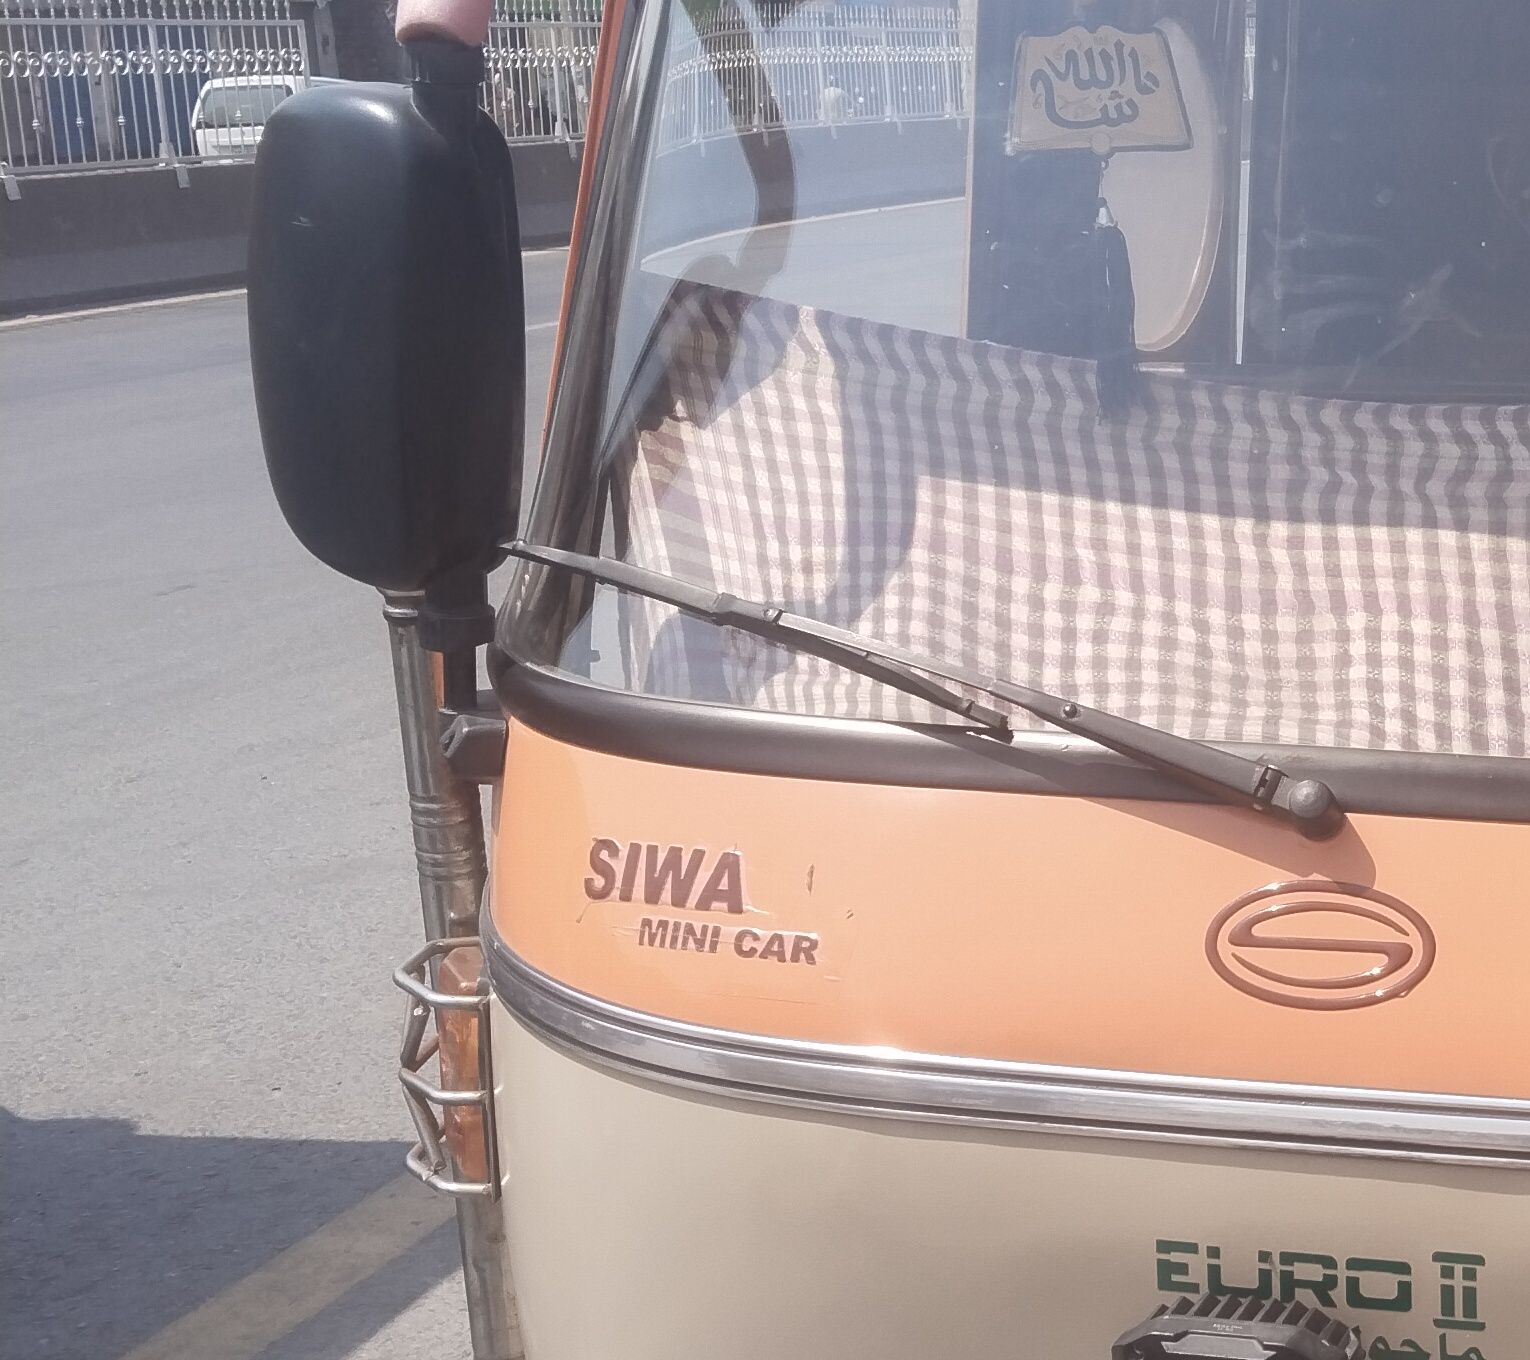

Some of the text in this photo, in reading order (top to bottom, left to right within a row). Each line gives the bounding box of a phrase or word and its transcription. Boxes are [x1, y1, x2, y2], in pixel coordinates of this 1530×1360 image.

[583, 838, 744, 914] SIWA
[638, 917, 819, 966] MINI CAR
[1155, 1239, 1412, 1313] EURO
